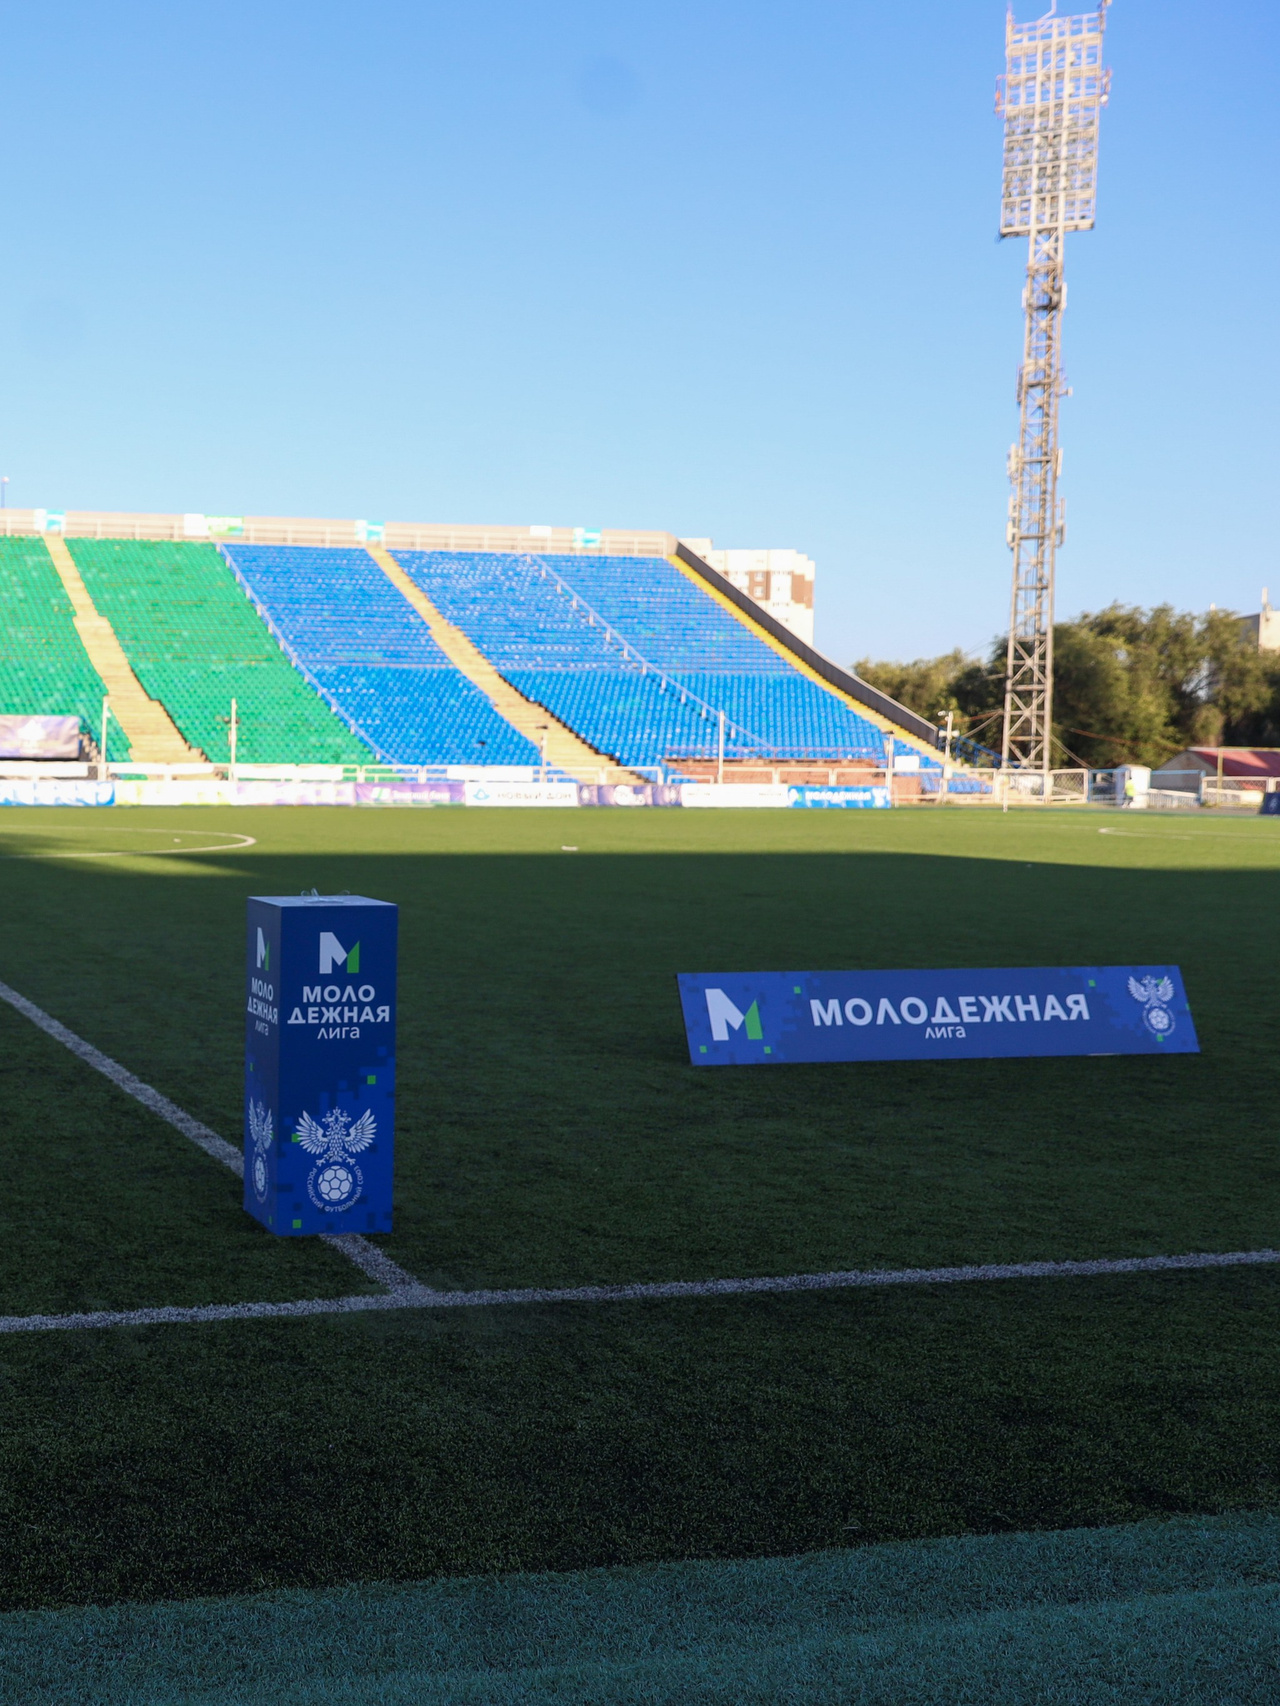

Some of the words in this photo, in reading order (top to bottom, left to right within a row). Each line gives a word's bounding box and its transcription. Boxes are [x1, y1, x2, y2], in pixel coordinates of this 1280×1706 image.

[251, 977, 274, 1001] МОЛО
[302, 985, 376, 1003] МОЛО
[247, 996, 278, 1025] ДЕЖНАЯ
[287, 1005, 390, 1024] ДЕЖНАЯ
[809, 993, 1091, 1027] МОЛОДЕЖНАЯ
[317, 1026, 360, 1039] лига
[924, 1024, 967, 1040] лига
